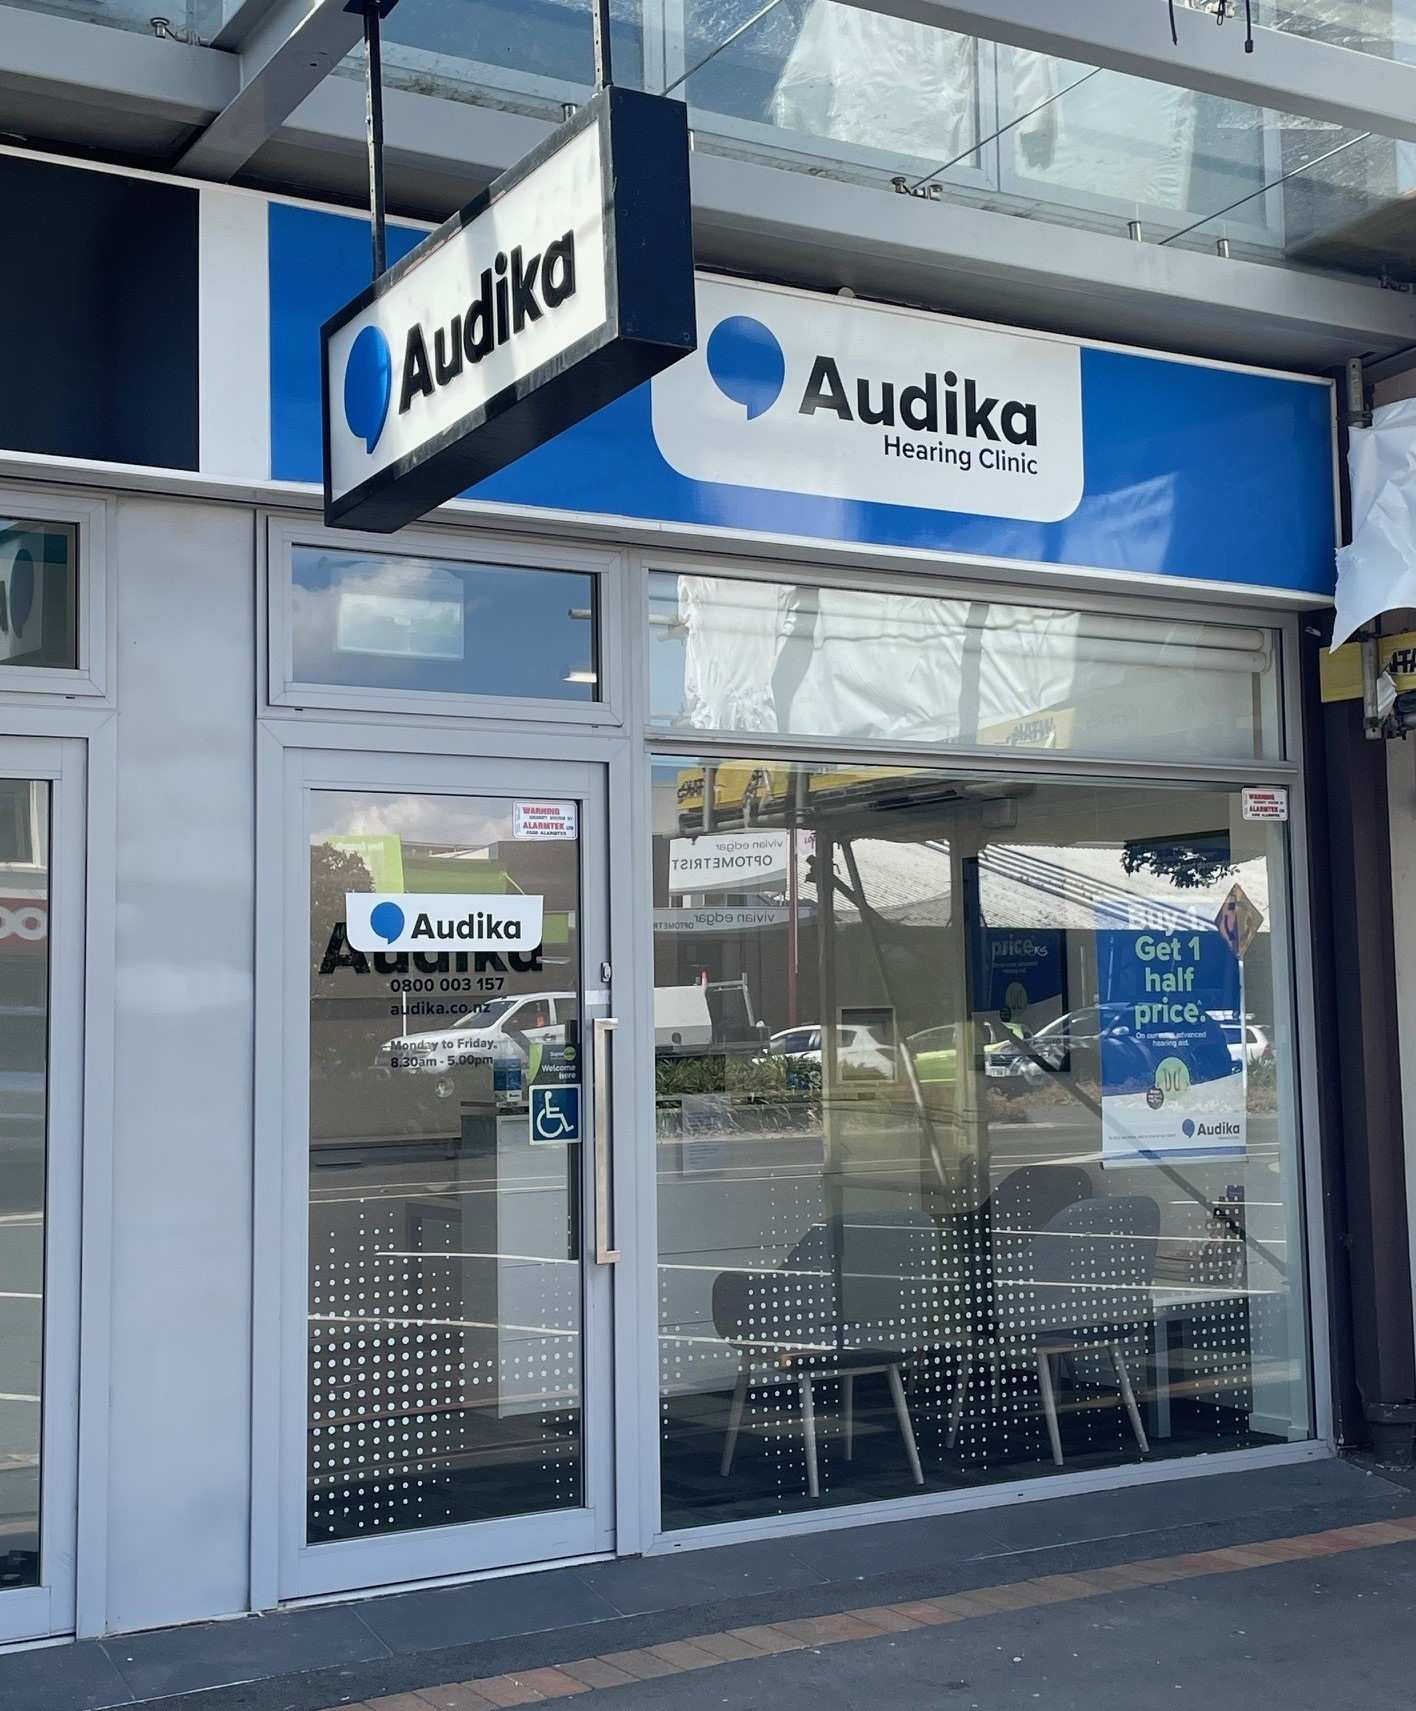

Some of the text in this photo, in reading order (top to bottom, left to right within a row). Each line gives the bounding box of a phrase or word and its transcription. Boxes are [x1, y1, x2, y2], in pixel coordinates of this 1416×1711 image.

[398, 229, 577, 415] Audika
[799, 354, 1038, 447] Audika
[883, 435, 1038, 476] Hearing Clinic
[411, 912, 521, 939] Audika
[1135, 935, 1200, 961] Get 1
[390, 977, 504, 992] 0800 003 157
[1144, 967, 1195, 992] half
[390, 1000, 491, 1016] audika.co.nz
[390, 1040, 439, 1052] Monday
[442, 1040, 454, 1049] to
[390, 1056, 437, 1069] 8.30am
[447, 1055, 494, 1068] 5.00pm
[541, 1064, 576, 1073] Welcome
[558, 1072, 577, 1080] here
[1197, 1122, 1240, 1136] Audika
